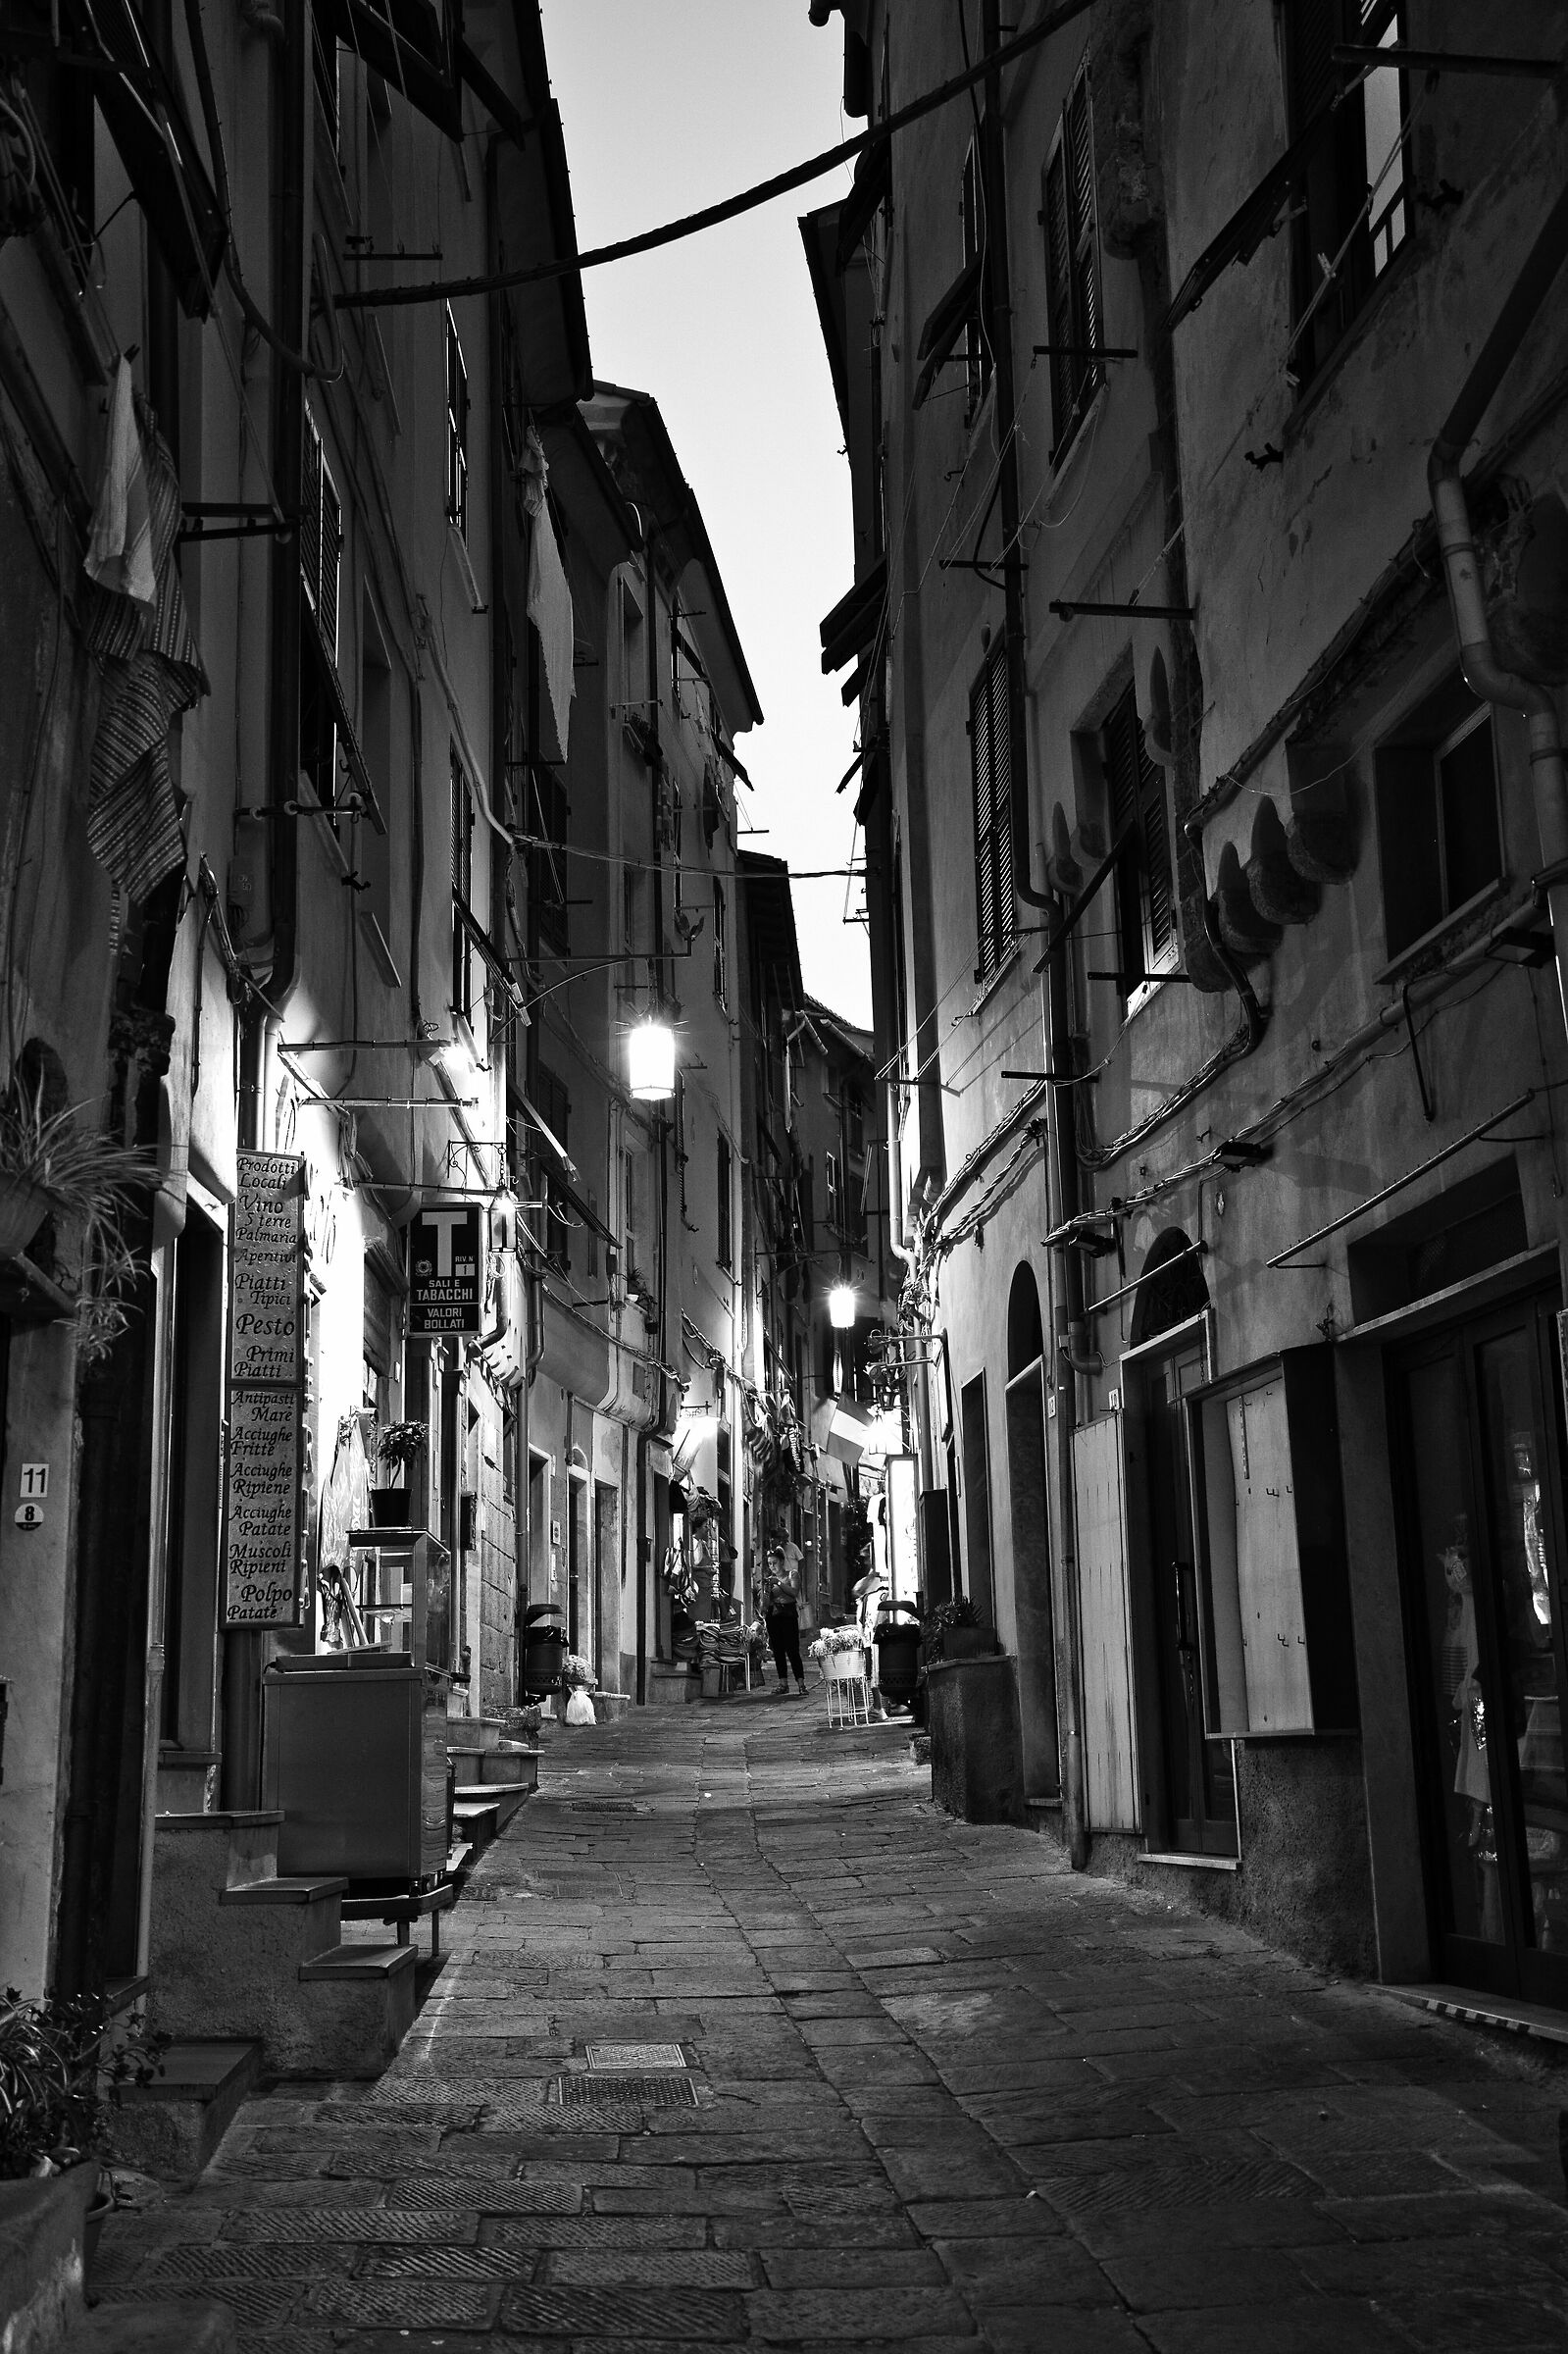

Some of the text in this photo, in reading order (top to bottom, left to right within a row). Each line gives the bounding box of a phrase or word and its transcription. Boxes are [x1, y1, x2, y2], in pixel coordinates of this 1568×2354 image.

[236, 1157, 295, 1175] Prodotti
[238, 1173, 287, 1190] Locali
[239, 1194, 283, 1214] Vino
[259, 1214, 291, 1229] terre
[235, 1227, 297, 1244] Palmaria
[422, 1211, 468, 1277] T
[235, 1249, 296, 1265] Aperitivi
[234, 1273, 286, 1291] Piatti
[429, 1279, 450, 1288] SALI
[250, 1290, 291, 1309] Tipici
[417, 1288, 473, 1301] TABACCHI
[427, 1307, 462, 1317] VALORI
[235, 1312, 295, 1336] Pesto
[424, 1318, 465, 1329] BOLLATI
[246, 1345, 294, 1363] Primi
[234, 1360, 281, 1378] Piatti
[231, 1391, 294, 1407] Antipasti
[251, 1407, 292, 1422] Mare
[230, 1426, 292, 1445] Acciughe
[229, 1441, 275, 1457] Fritte
[24, 1467, 46, 1493] 11
[230, 1461, 292, 1482] Acciughe
[232, 1478, 290, 1499] Ripiene
[25, 1506, 34, 1521] 8
[228, 1505, 291, 1523] Acciughe
[238, 1521, 291, 1537] Patate
[228, 1541, 291, 1560] Muscoli
[229, 1559, 286, 1579] Ripieni
[241, 1581, 293, 1608] Polpo
[228, 1605, 278, 1620] Patate
